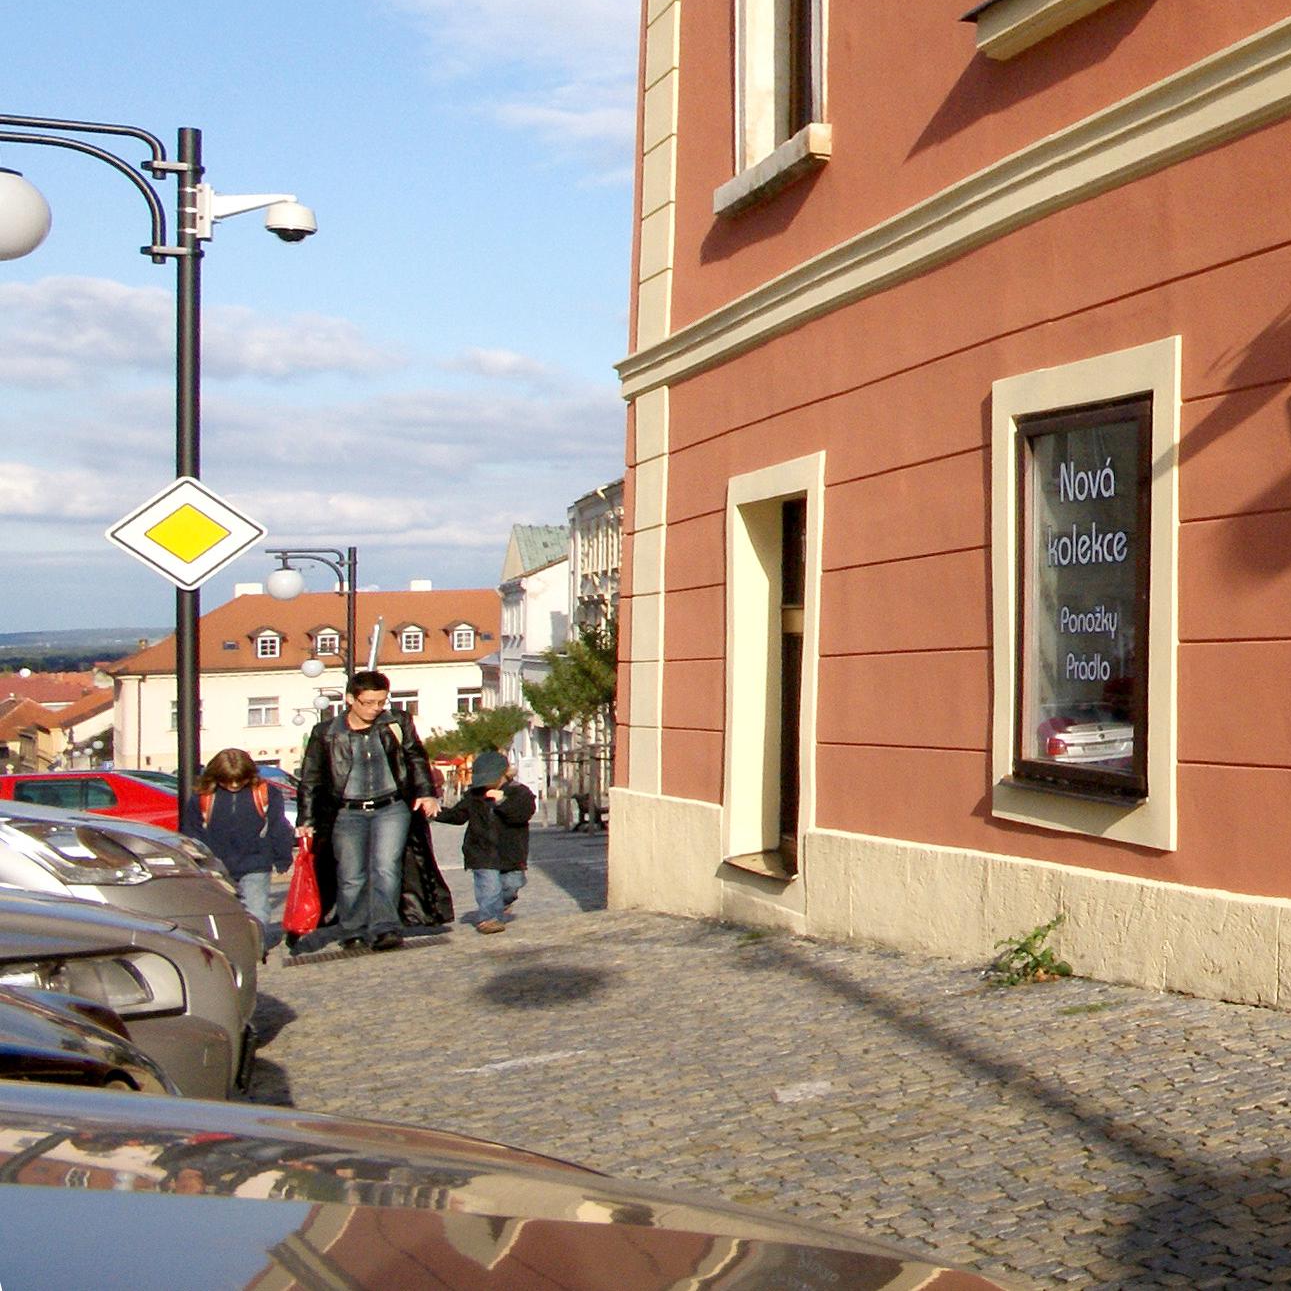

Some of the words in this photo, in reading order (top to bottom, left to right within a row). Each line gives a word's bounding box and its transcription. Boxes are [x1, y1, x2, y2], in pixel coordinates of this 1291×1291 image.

[1060, 458, 1115, 501] Nová
[1048, 522, 1127, 567] kolekce
[1061, 605, 1117, 639] Ponožky
[1067, 653, 1110, 680] Prádlo
